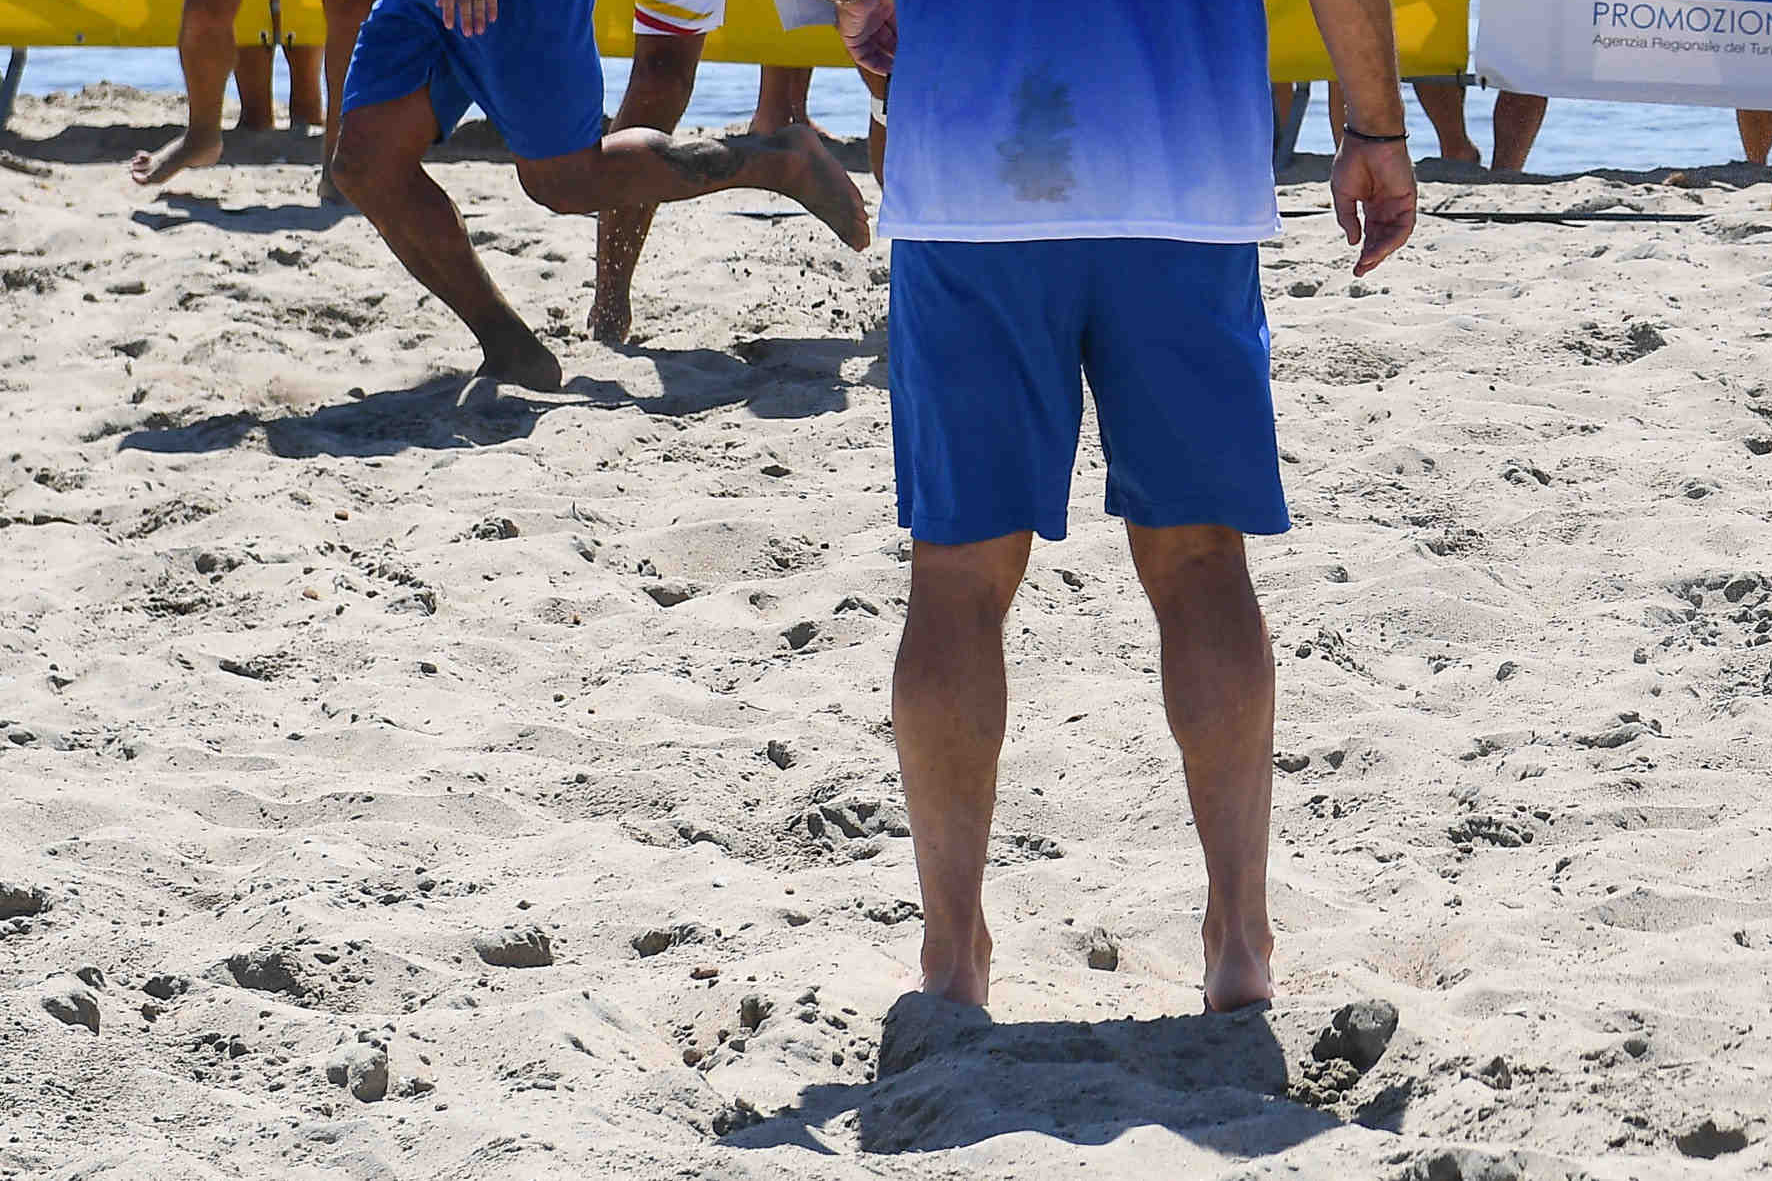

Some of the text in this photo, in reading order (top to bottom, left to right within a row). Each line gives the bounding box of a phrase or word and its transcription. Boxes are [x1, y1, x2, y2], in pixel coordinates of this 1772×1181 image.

[1592, 33, 1648, 49] Agenzia
[1651, 37, 1721, 53] Regionale
[1724, 41, 1746, 53] del
